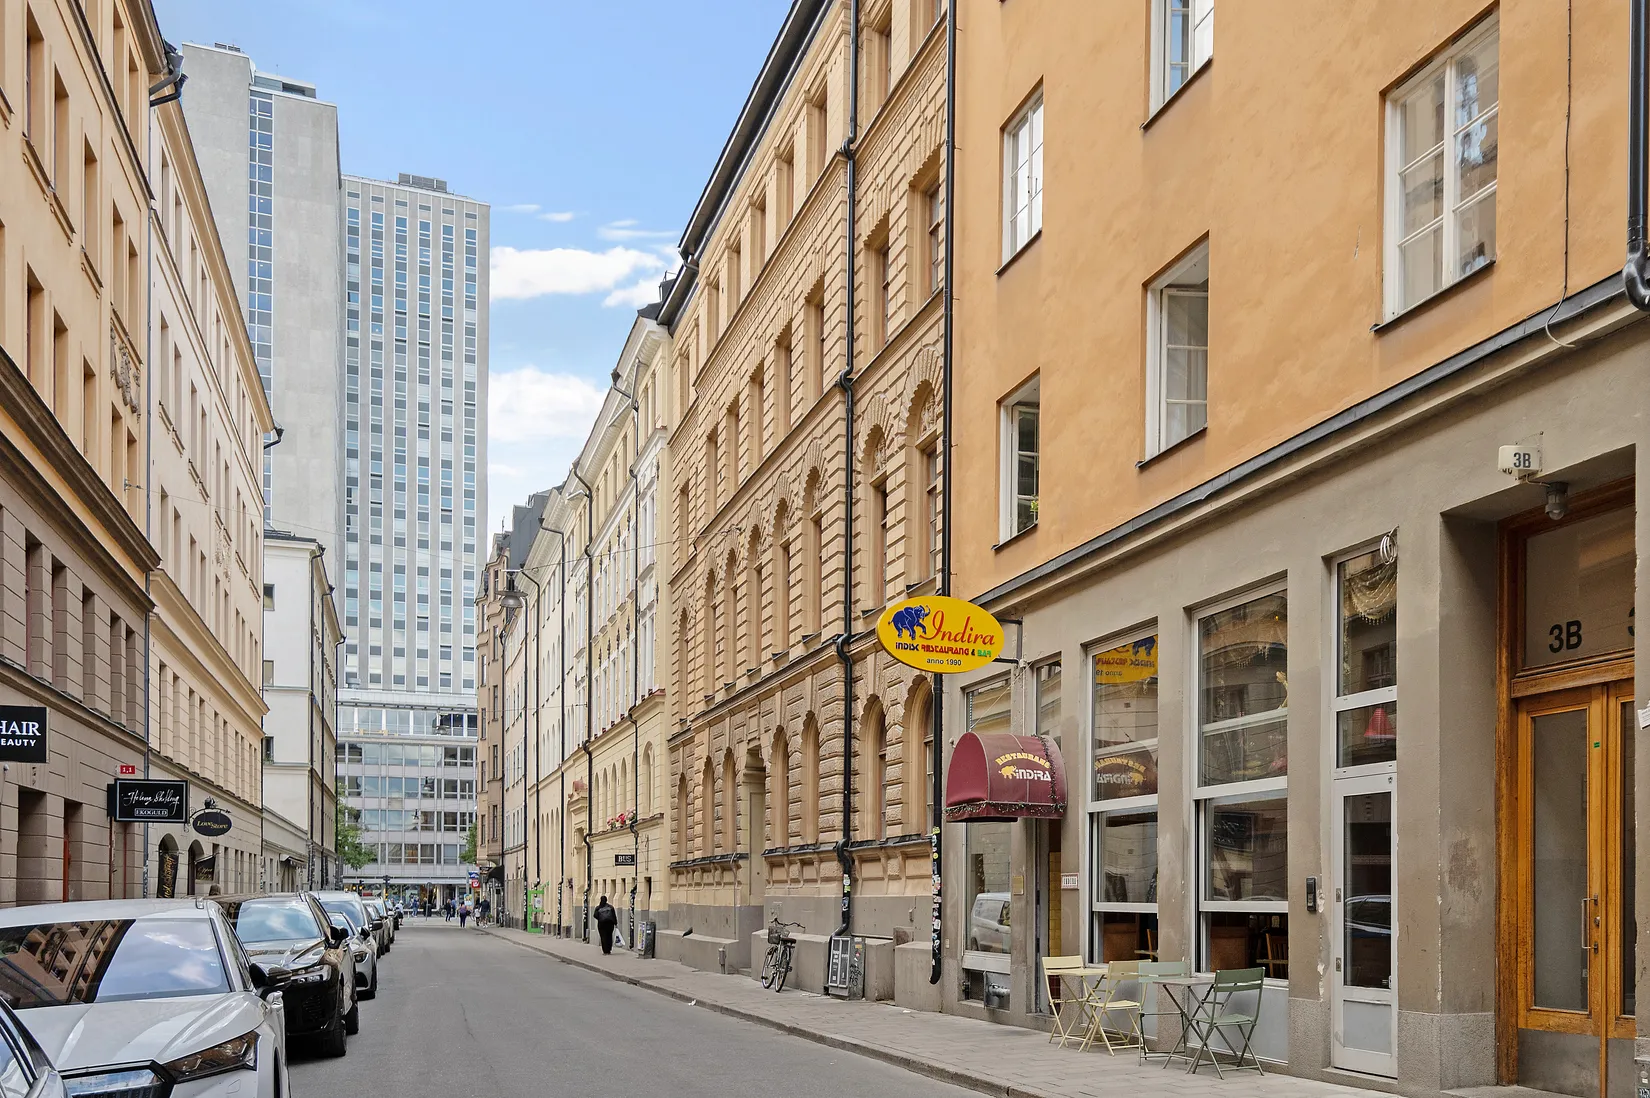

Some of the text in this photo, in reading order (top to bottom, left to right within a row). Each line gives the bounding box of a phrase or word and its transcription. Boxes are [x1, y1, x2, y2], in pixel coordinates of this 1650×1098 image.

[1513, 452, 1532, 468] 3B
[918, 610, 996, 646] Indira
[1548, 620, 1583, 654] 3B
[926, 657, 962, 666] anno 1990
[994, 752, 1051, 769] RESTAURANG
